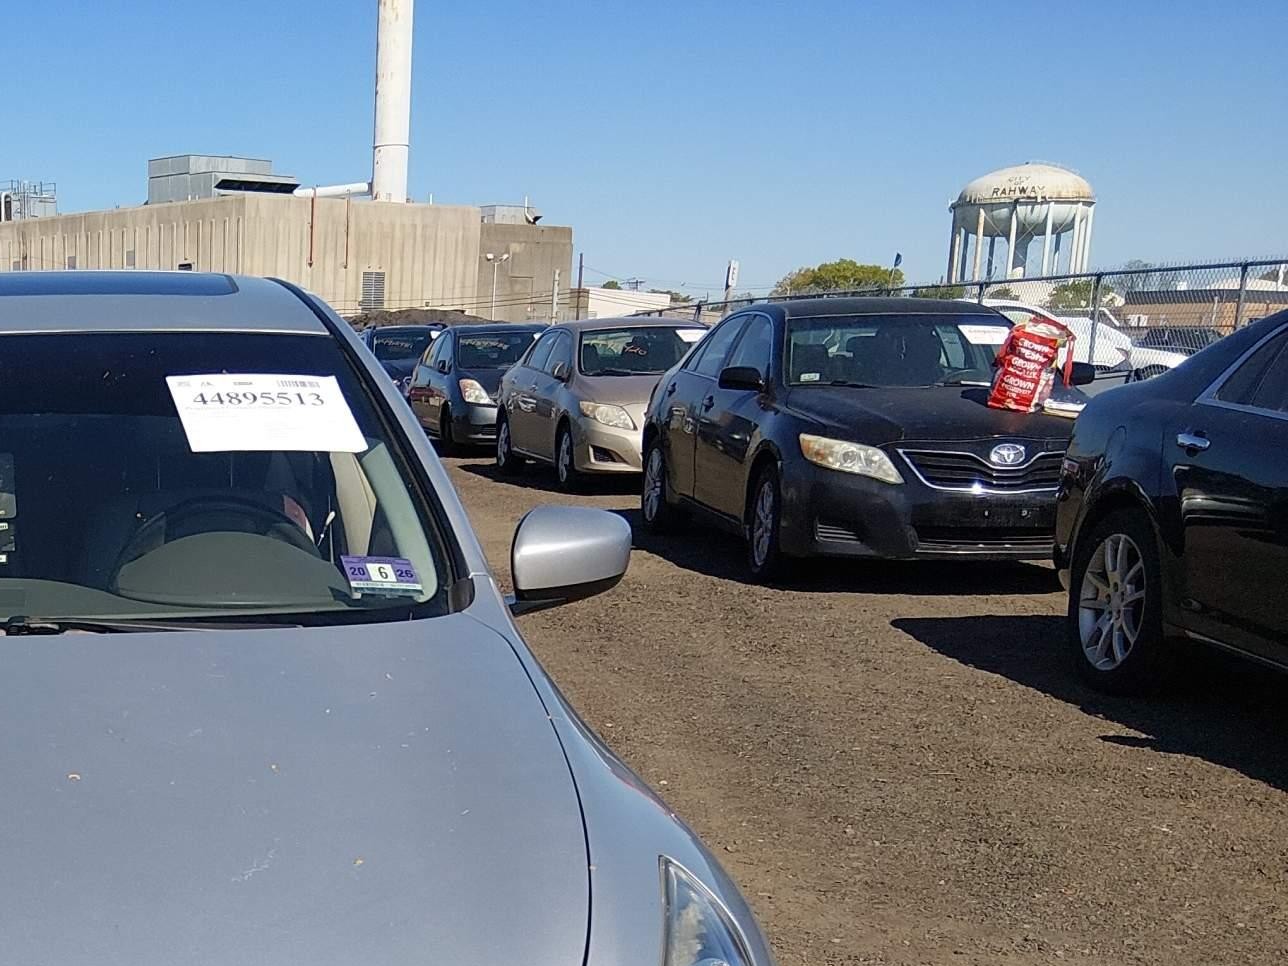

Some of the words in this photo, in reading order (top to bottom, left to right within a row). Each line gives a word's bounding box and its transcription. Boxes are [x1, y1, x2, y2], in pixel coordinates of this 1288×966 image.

[992, 186, 1046, 196] RAHWAY
[1011, 356, 1041, 371] GROWN
[1003, 375, 1035, 390] GROWN
[193, 392, 324, 406] 44895513
[349, 567, 365, 576] 20
[378, 567, 388, 579] 6
[397, 569, 413, 578] 26
